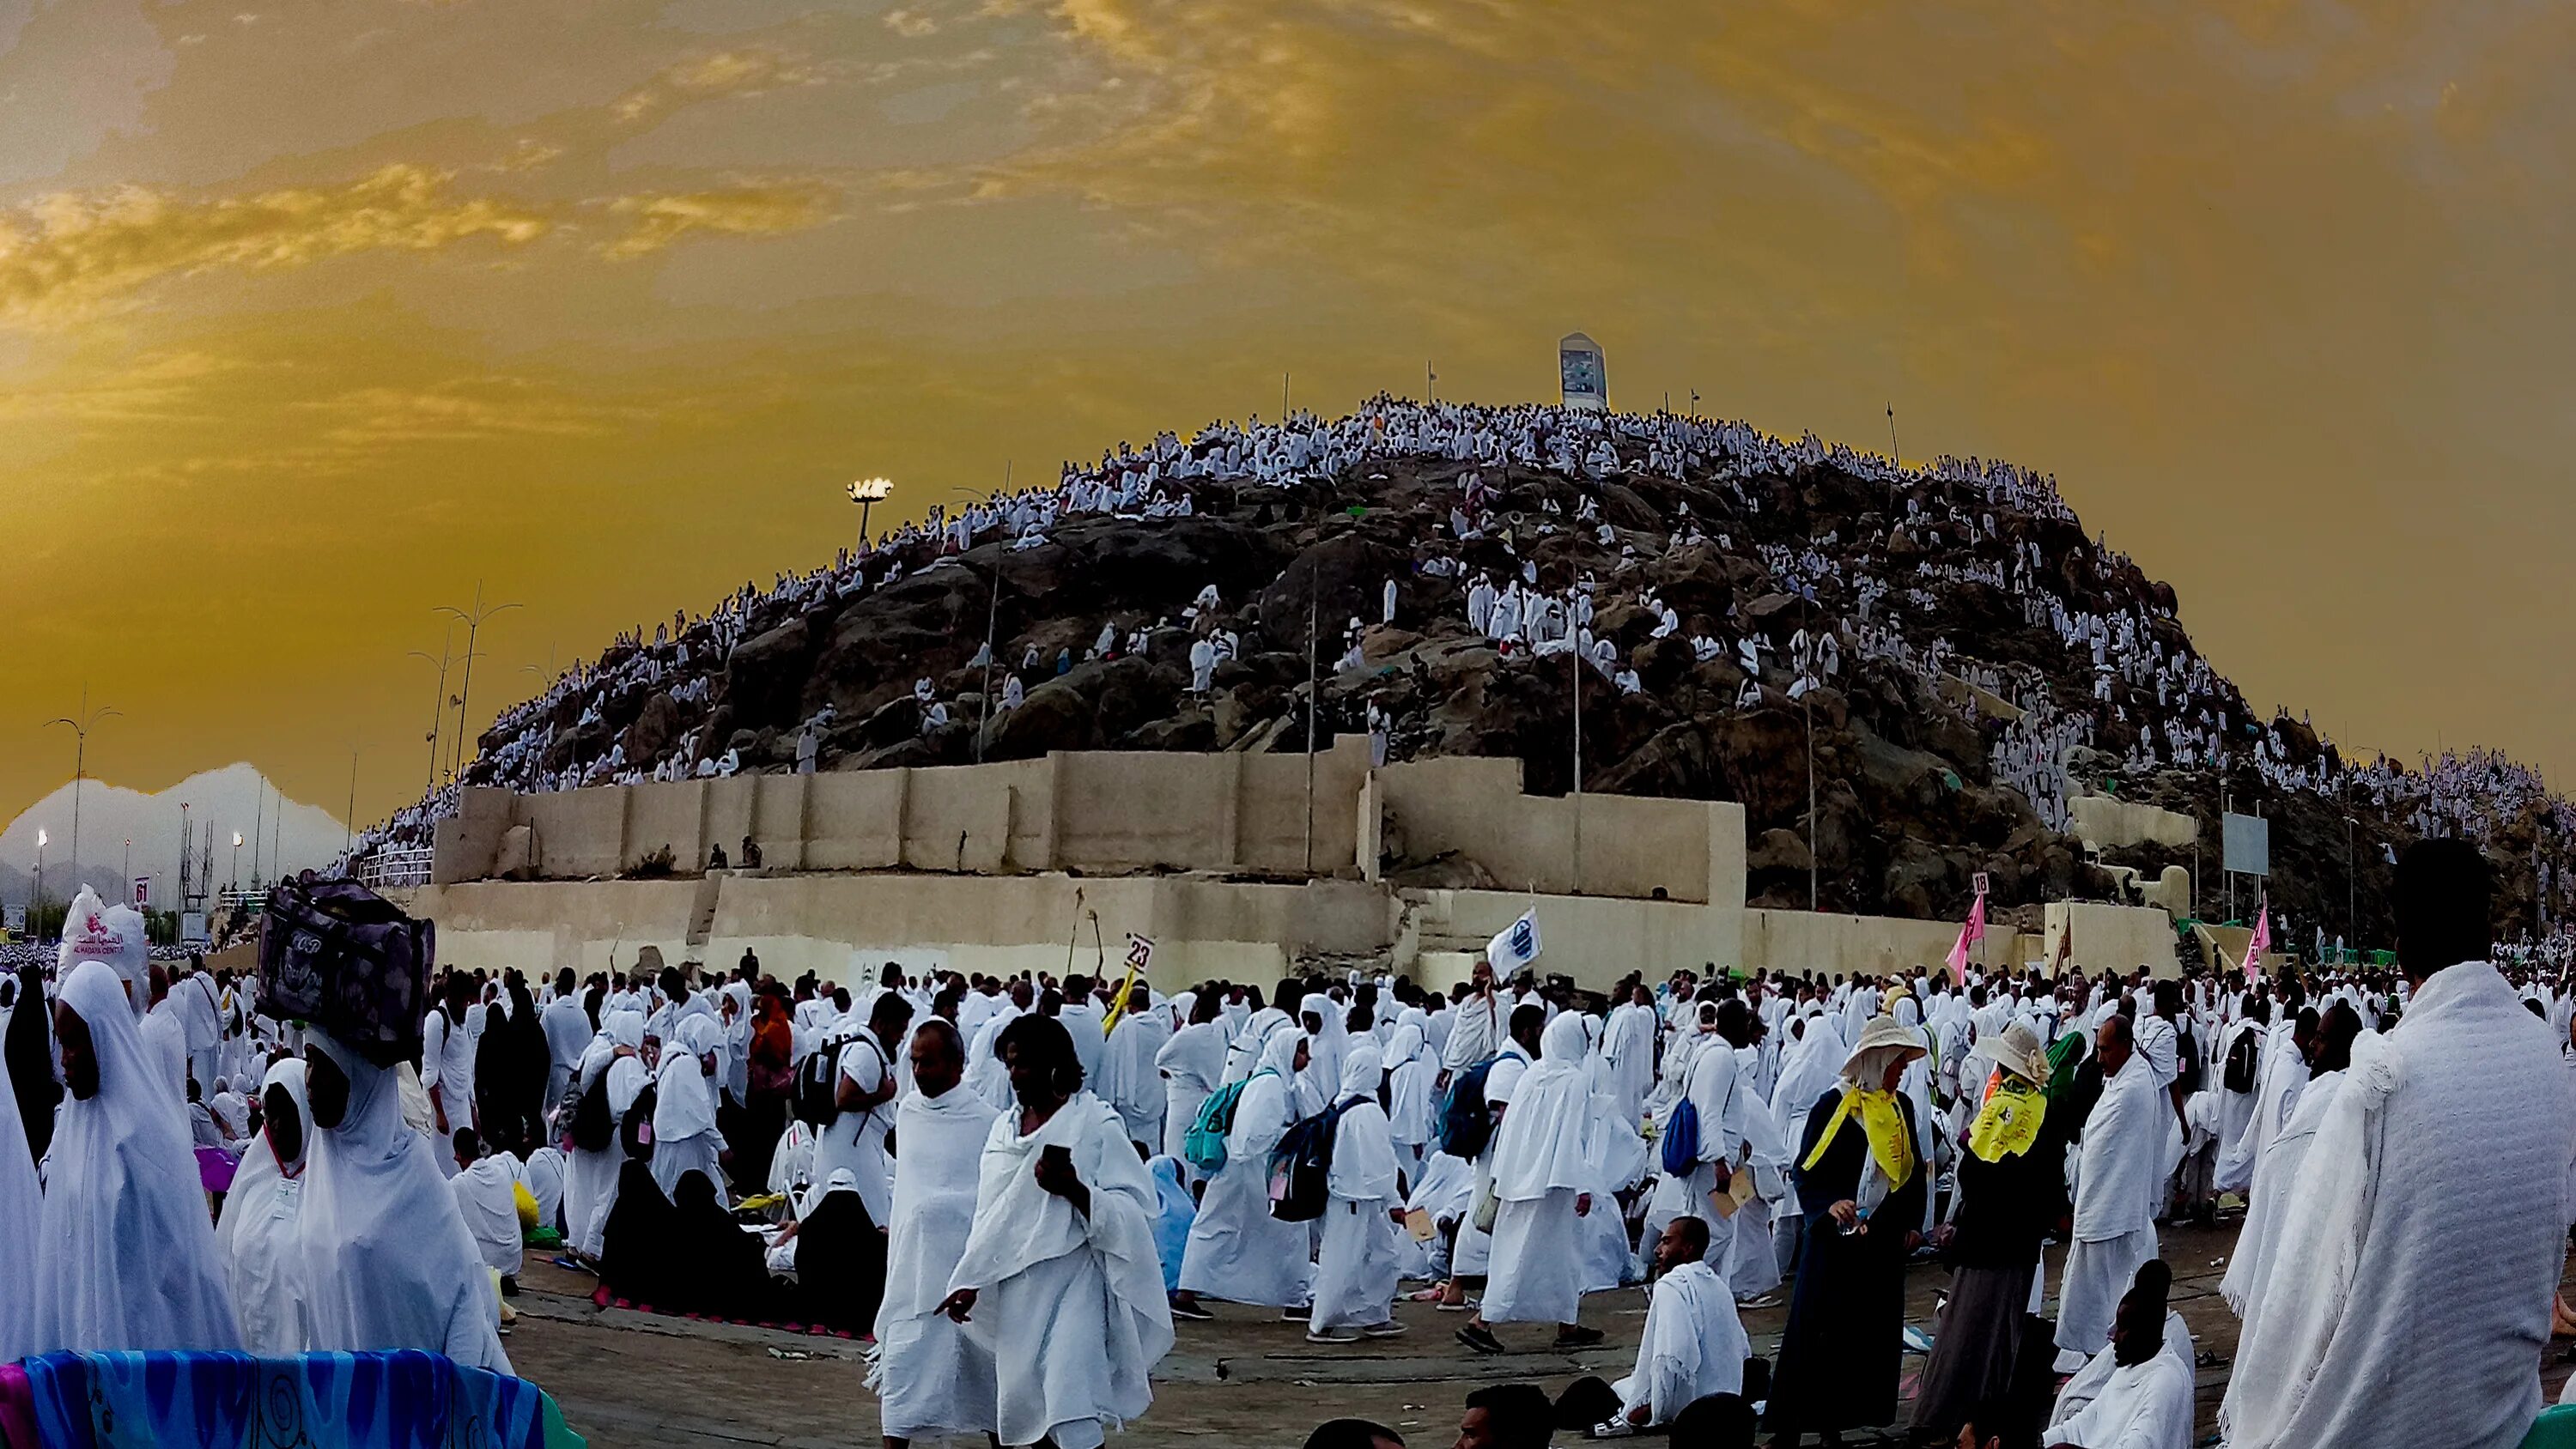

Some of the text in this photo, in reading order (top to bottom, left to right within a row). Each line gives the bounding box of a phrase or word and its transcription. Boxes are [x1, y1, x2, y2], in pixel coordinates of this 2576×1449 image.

[136, 883, 147, 902] 61
[1975, 876, 1987, 892] 18
[1127, 940, 1150, 967] 23
